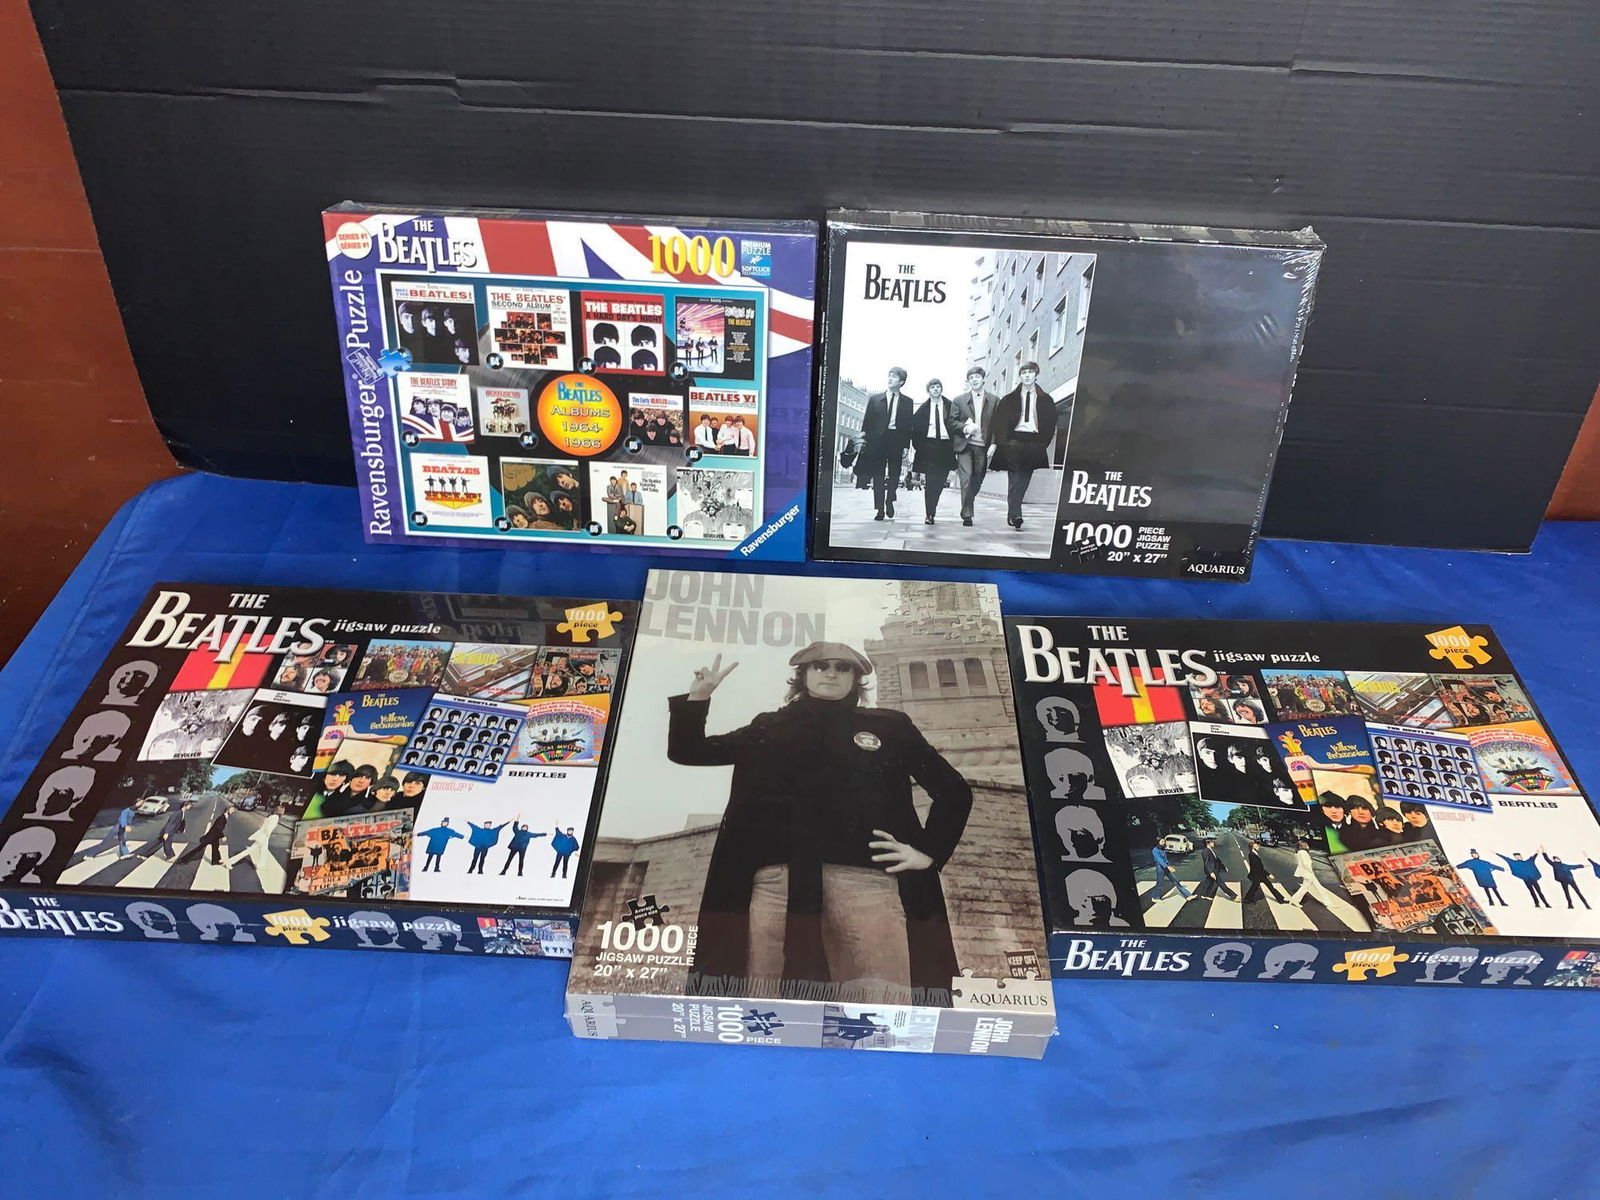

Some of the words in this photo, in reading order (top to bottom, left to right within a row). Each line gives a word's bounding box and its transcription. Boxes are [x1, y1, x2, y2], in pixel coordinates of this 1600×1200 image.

[412, 220, 434, 232] THE
[376, 218, 478, 273] BEATLES
[741, 247, 772, 256] PUZZLE
[647, 235, 736, 277] 1000
[898, 264, 916, 274] THE
[863, 263, 947, 308] BEATLES
[409, 290, 472, 299] BEATLES!
[491, 292, 512, 301] THE
[340, 270, 370, 349] Puzzle
[584, 301, 608, 313] THE
[611, 302, 662, 316] BEATLES
[420, 377, 440, 386] BEATLES
[557, 382, 602, 404] BEATLES
[690, 392, 740, 402] BEATLES
[743, 395, 756, 403] VI
[551, 405, 610, 417] ALBUMS
[565, 437, 601, 448] 1966
[358, 380, 392, 536] Ravensburger
[422, 465, 480, 475] BEATLES
[1104, 471, 1123, 481] THE
[1068, 470, 1153, 512] BEATLES
[740, 504, 801, 557] Ravensburger
[1062, 522, 1133, 548] 1000
[1138, 526, 1165, 535] PIECE
[1136, 534, 1171, 543] JIGSAW
[1135, 542, 1169, 551] PUZZLE
[1187, 563, 1246, 575] AQUARIUS
[645, 570, 765, 609] JOHN
[228, 593, 270, 610] THE
[568, 609, 607, 622] 1000
[126, 590, 330, 665] BEATLES
[333, 618, 387, 634] jigsaw
[389, 622, 441, 635] puzzle
[573, 621, 599, 629] piece
[637, 600, 826, 648] LENNON
[1087, 625, 1130, 641] THE
[1433, 633, 1471, 648] 1000
[1214, 650, 1266, 664] jigsaw
[1270, 651, 1321, 665] puzzle
[1444, 646, 1470, 655] piece
[1016, 624, 1218, 697] BEATLES
[361, 694, 400, 708] BEATLES
[1298, 724, 1338, 738] BEATLES
[173, 751, 202, 760] REVOLVER
[508, 770, 567, 779] BEATLES
[1498, 800, 1558, 808] BEATLES
[29, 897, 60, 907] THE
[332, 916, 396, 930] jigsaw
[402, 920, 462, 933] puzzle
[597, 920, 684, 954] 1000
[686, 925, 699, 956] PIECE
[1120, 939, 1147, 948] THE
[595, 952, 645, 964] JIGSAW
[647, 954, 694, 966] PUZZLE
[1008, 956, 1023, 965] KEEP
[1023, 955, 1037, 965] OFF
[1063, 939, 1192, 977] BEATLES
[1350, 951, 1392, 963] 1000
[1410, 951, 1478, 965] jigsaw
[1480, 955, 1544, 966] puzzle
[970, 993, 1048, 1007] AQUARIUS
[689, 1003, 701, 1032] PUZZLE
[702, 1004, 714, 1033] JIGSAW
[717, 1004, 744, 1043] 1000
[969, 1017, 993, 1054] LENNON
[991, 1017, 1014, 1044] JOHN
[746, 1036, 782, 1044] PIECE
